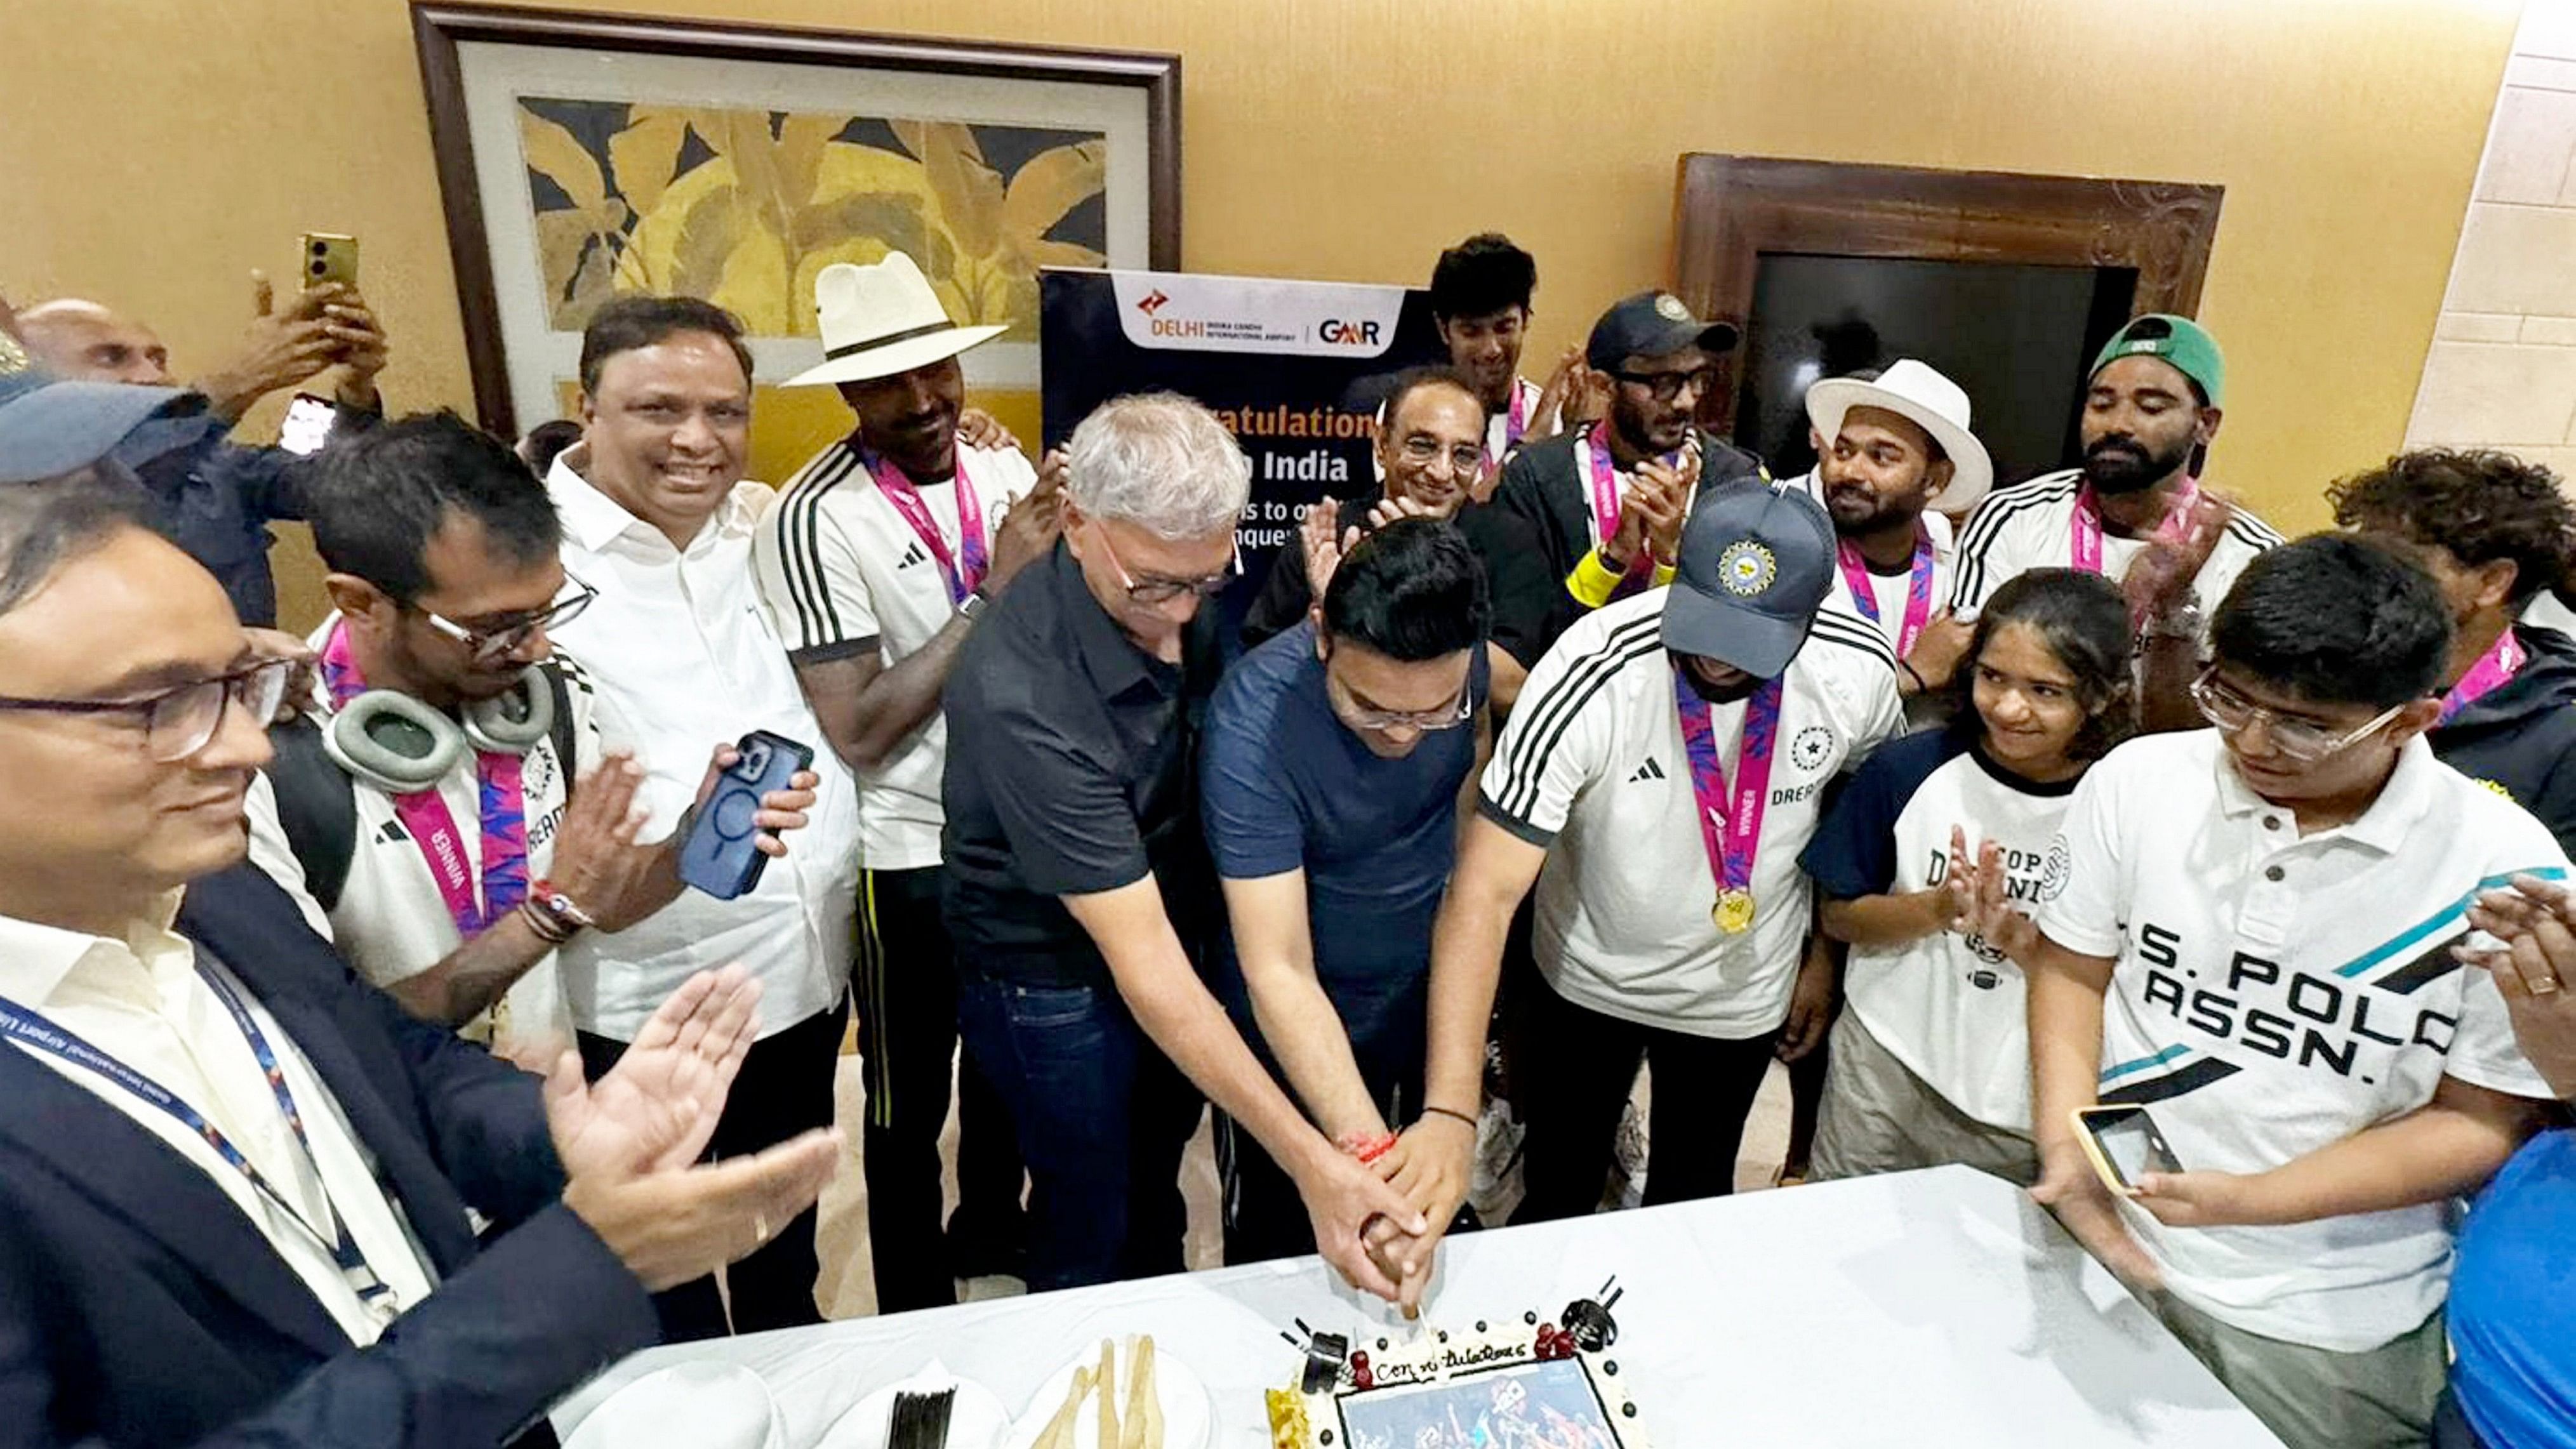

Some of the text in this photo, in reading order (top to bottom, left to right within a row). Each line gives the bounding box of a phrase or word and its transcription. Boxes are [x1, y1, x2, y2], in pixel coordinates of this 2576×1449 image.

[1151, 319, 1205, 338] DELHI
[1319, 319, 1380, 345] GMR
[1264, 449, 1348, 482] India
[1265, 501, 1287, 521] to
[1293, 504, 1308, 521] o
[1772, 783, 1814, 806] DREA
[1737, 789, 1756, 837] WINNER
[431, 827, 466, 890] WINNER
[2143, 969, 2374, 1085] ASSN.
